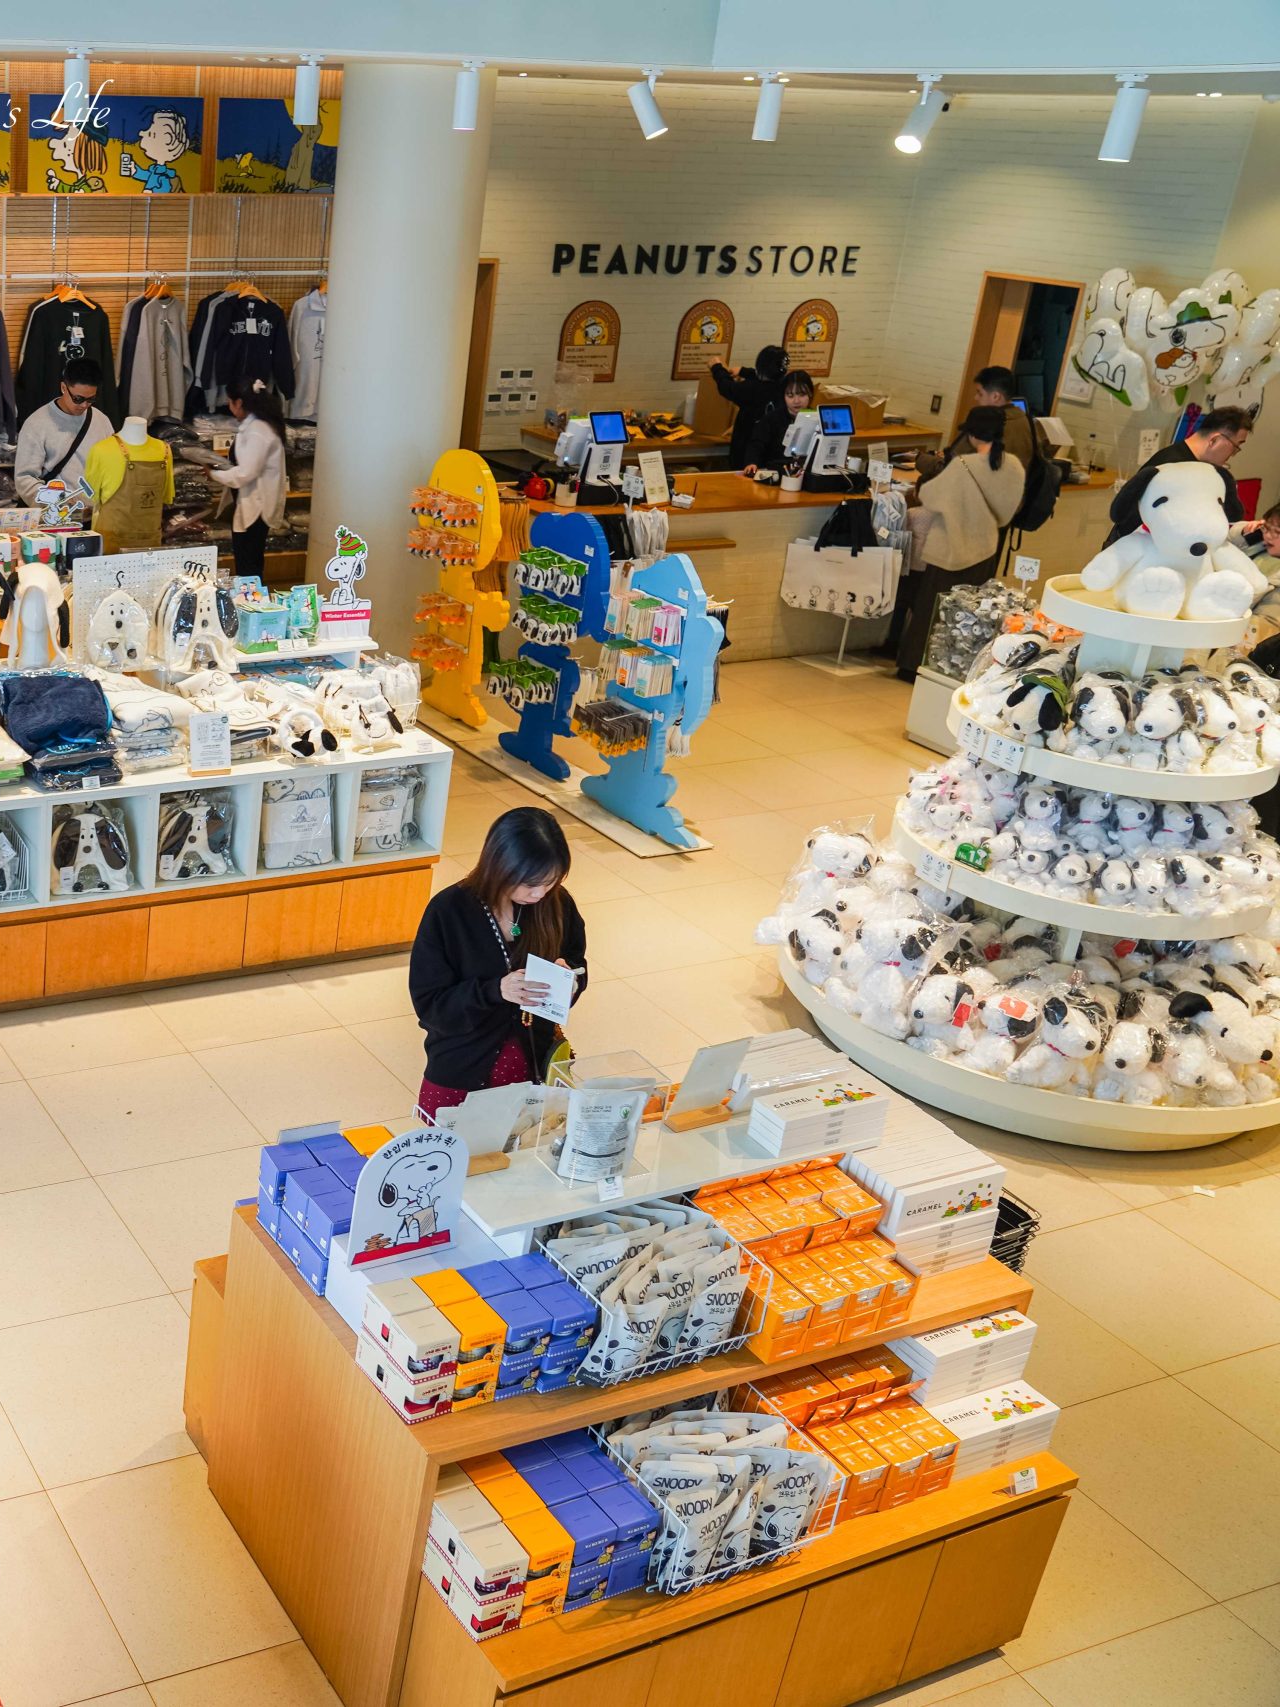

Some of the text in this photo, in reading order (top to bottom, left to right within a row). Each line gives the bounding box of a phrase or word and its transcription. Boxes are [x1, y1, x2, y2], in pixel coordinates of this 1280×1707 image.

[551, 243, 862, 276] PEANUTS STORE
[343, 611, 366, 619] Essential
[957, 850, 976, 863] No. 1
[774, 1097, 811, 1109] CARAMEL
[382, 1139, 411, 1160] 한입에
[414, 1133, 442, 1145] 제주가
[906, 1203, 943, 1217] CARAMEL
[705, 1291, 742, 1306] SNOOPY
[923, 1326, 961, 1342] CARAMEL
[942, 1409, 981, 1425] CARAMEL
[653, 1477, 703, 1489] SNOOPY
[773, 1472, 815, 1490] SNOOPY
[675, 1498, 713, 1518] SNOOPY
[700, 1509, 730, 1539] SNOOPY
